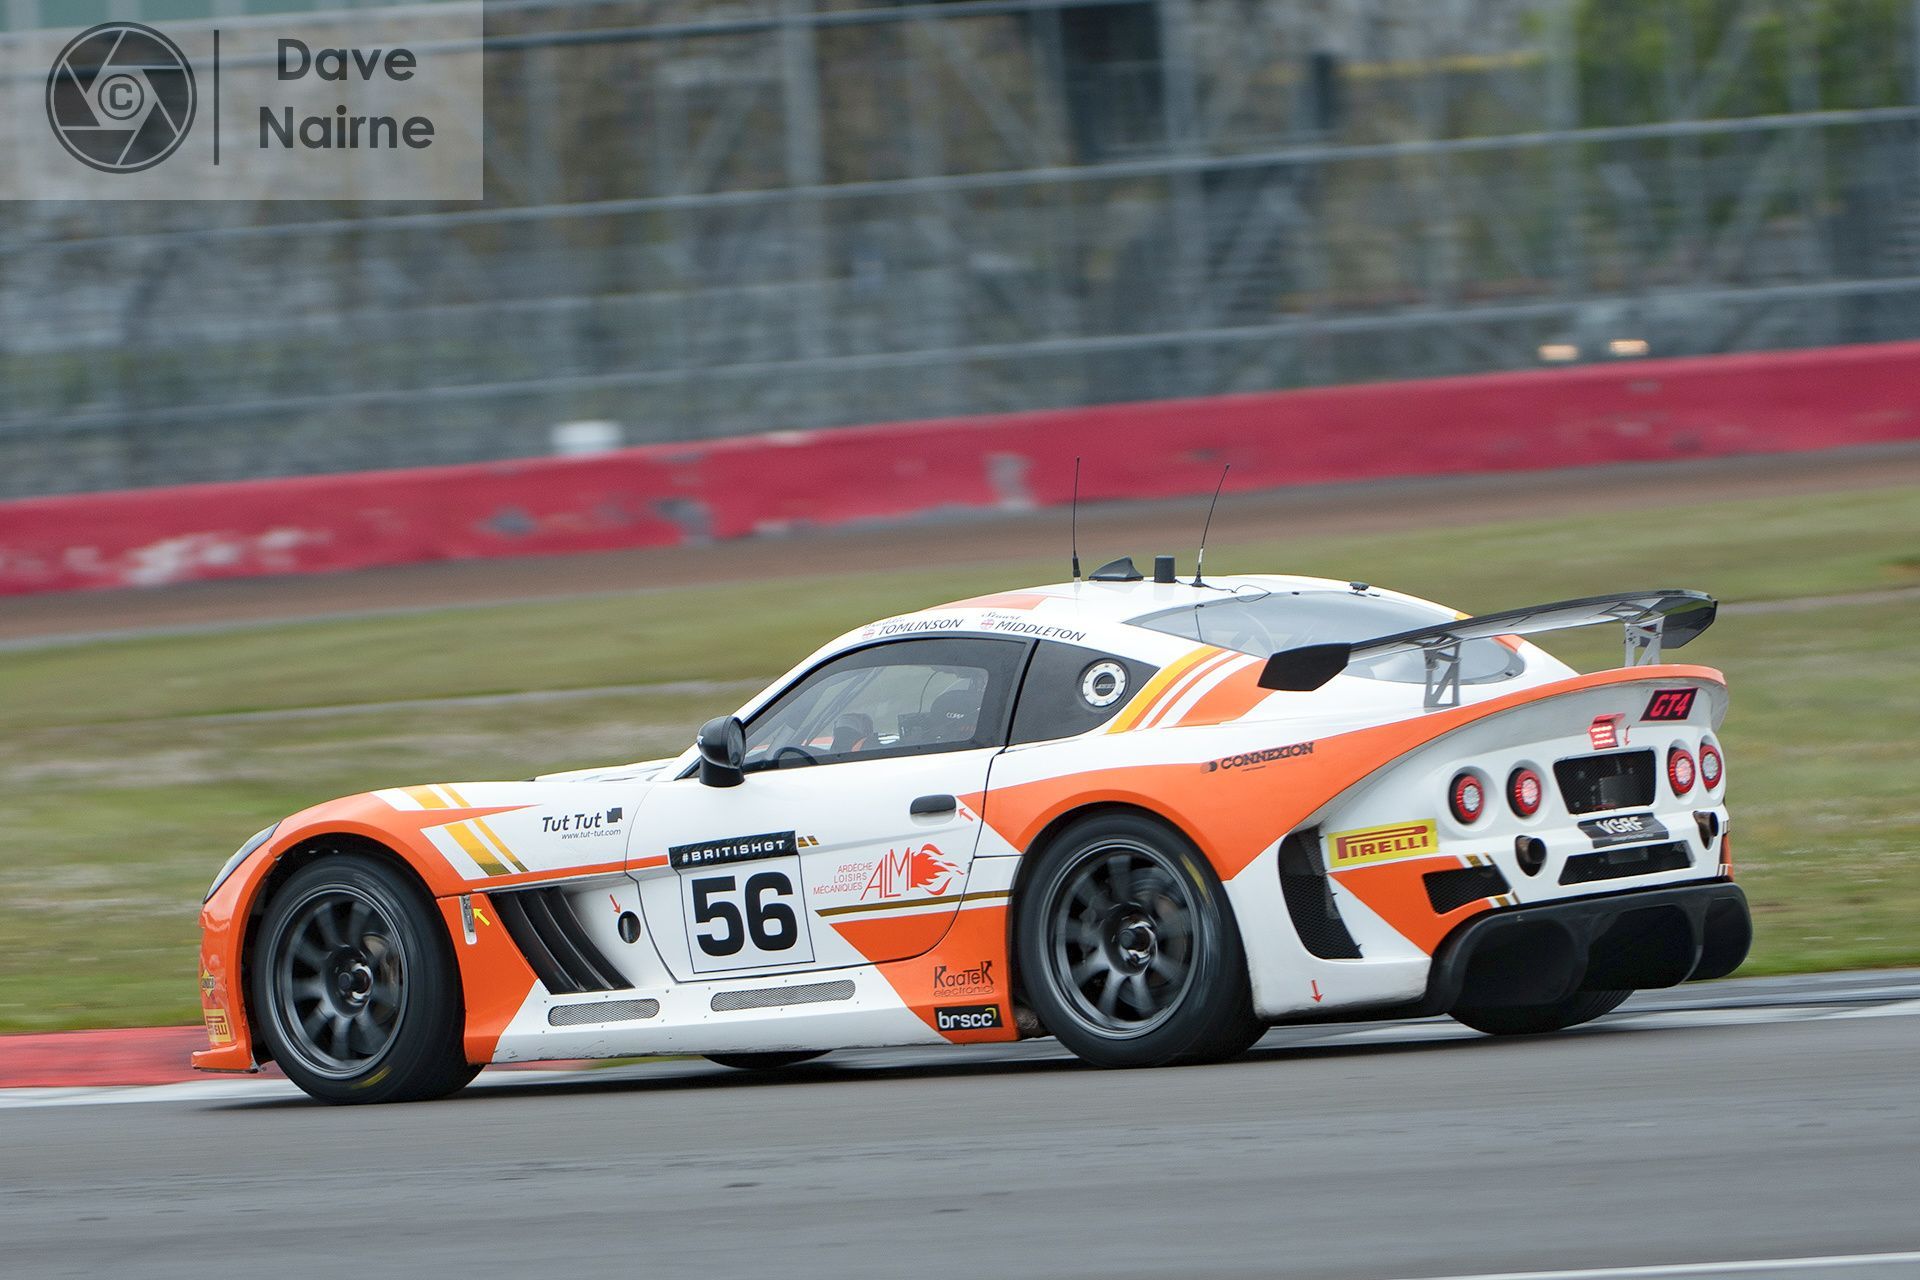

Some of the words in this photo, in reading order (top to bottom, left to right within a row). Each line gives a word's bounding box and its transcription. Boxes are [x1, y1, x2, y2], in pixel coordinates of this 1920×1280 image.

[878, 619, 965, 636] TOMLINSON
[993, 620, 1087, 642] MIDDLETON
[1649, 692, 1692, 719] GT4
[1220, 742, 1314, 770] CONNEXION
[542, 815, 570, 832] Tut
[574, 812, 602, 830] Tut
[561, 828, 621, 840] www.tut-tut.com
[1336, 825, 1428, 859] PIRELLI
[682, 840, 786, 863] #BRITISHGT
[813, 882, 863, 895] MÉCANIQUES
[834, 872, 868, 884] LOISIRS
[691, 871, 798, 957] 56
[938, 1011, 992, 1029] brscc
